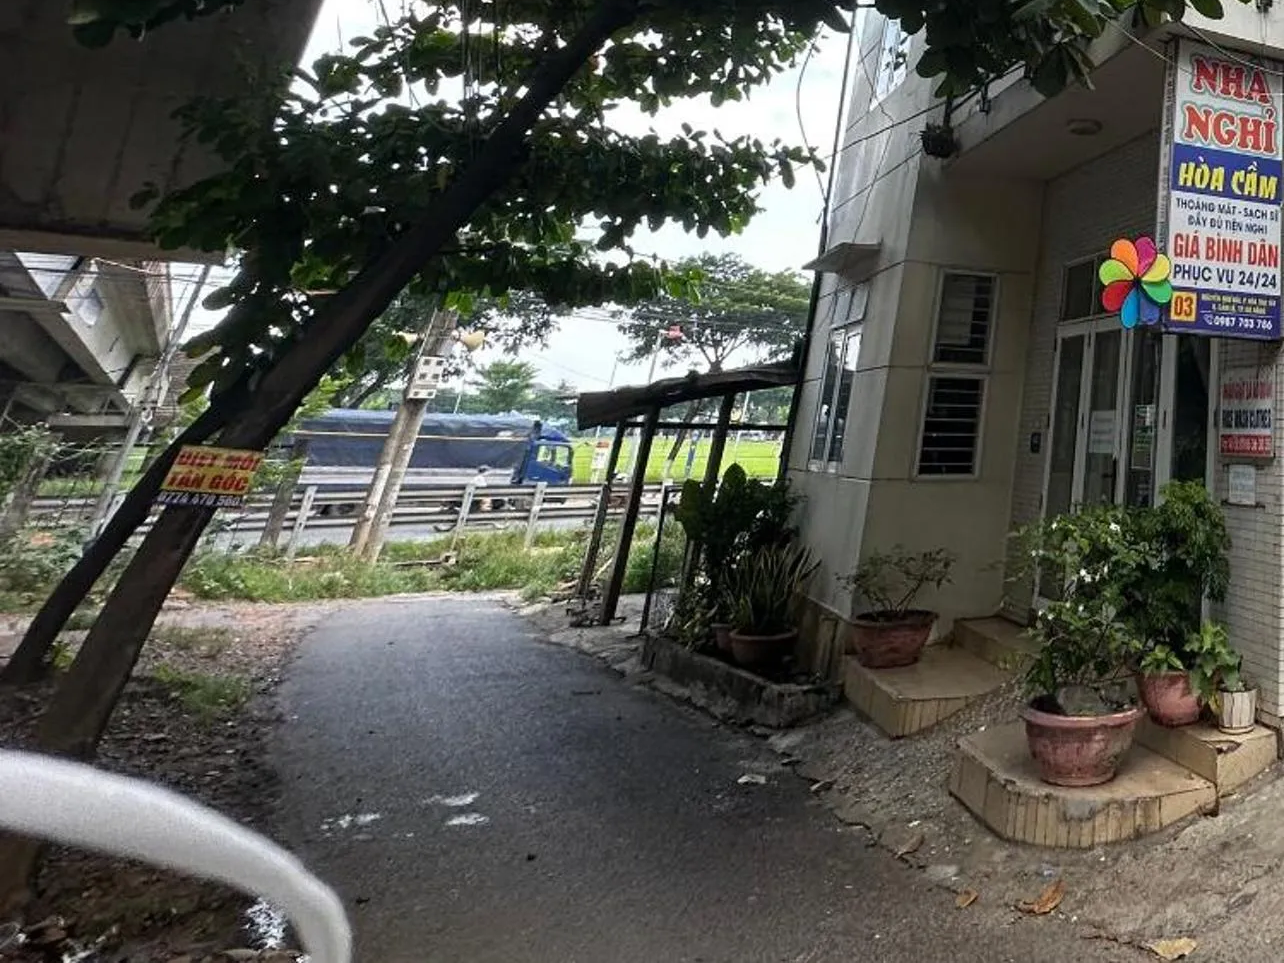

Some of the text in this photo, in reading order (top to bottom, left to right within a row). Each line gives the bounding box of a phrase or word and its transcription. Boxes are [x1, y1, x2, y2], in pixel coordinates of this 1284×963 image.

[1183, 104, 1277, 154] NGHỈ
[1178, 156, 1225, 191] HÒA
[1173, 230, 1279, 268] GIÁ BÌNH DÂN
[1173, 264, 1277, 289] PHỤC VỤ 24/24
[1173, 295, 1194, 317] 03
